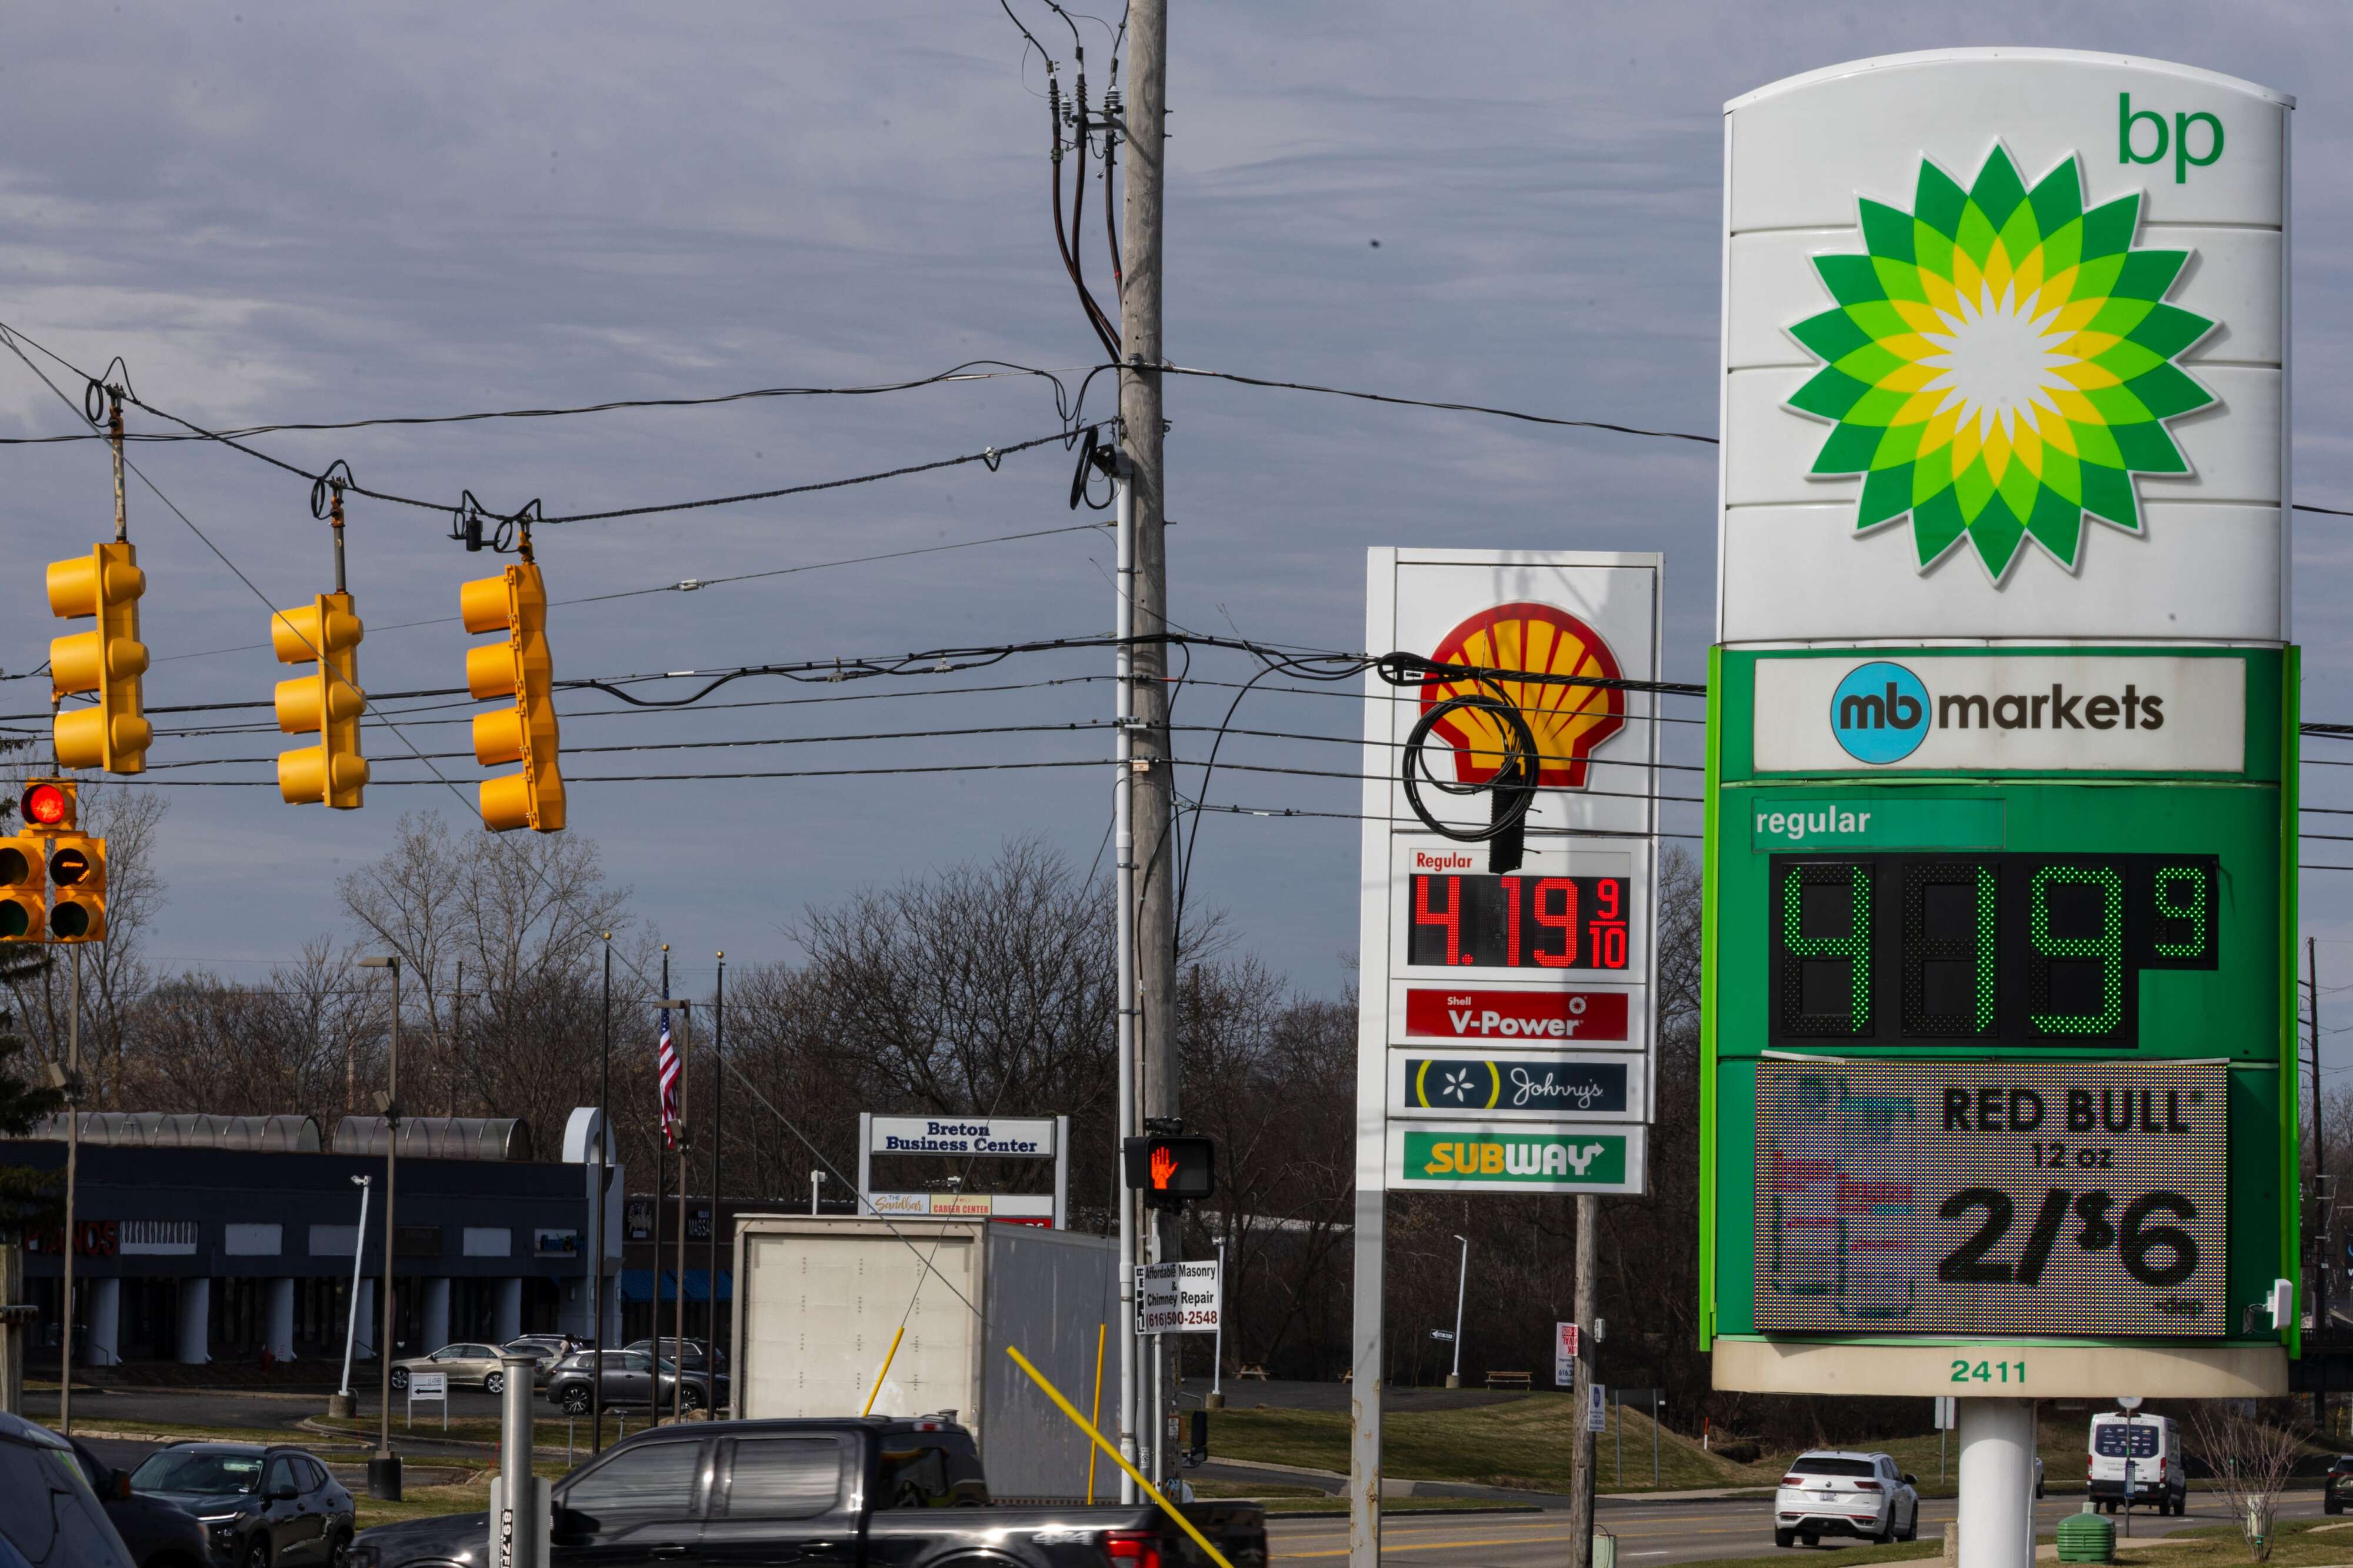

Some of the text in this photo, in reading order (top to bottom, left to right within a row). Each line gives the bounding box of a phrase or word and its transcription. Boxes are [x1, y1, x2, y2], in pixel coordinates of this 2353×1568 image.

[2119, 92, 2224, 184] bp
[1839, 682, 2164, 730] mb markets
[1756, 805, 1871, 839] regular
[1417, 852, 1472, 872] Regular
[1447, 996, 1471, 1006] Shell
[1448, 1009, 1579, 1036] V-Power
[1510, 1067, 1604, 1109] Johnny's
[1945, 1088, 2189, 1133] RED BULL
[927, 1122, 990, 1136] Breton
[886, 1136, 1037, 1152] Business Center
[1424, 1142, 1605, 1176] SUBWAY
[2033, 1142, 2114, 1168] 12 oz
[875, 1195, 924, 1212] Sandbar
[934, 1205, 989, 1214] CAREER CENTER
[688, 1219, 713, 1236] MASSA
[1145, 1264, 1216, 1280] Affordable Masonry
[1171, 1281, 1177, 1291] &
[1147, 1291, 1214, 1307] Chimney Repair
[1950, 1360, 2026, 1383] 2411
[502, 1510, 512, 1568] 89.7F
